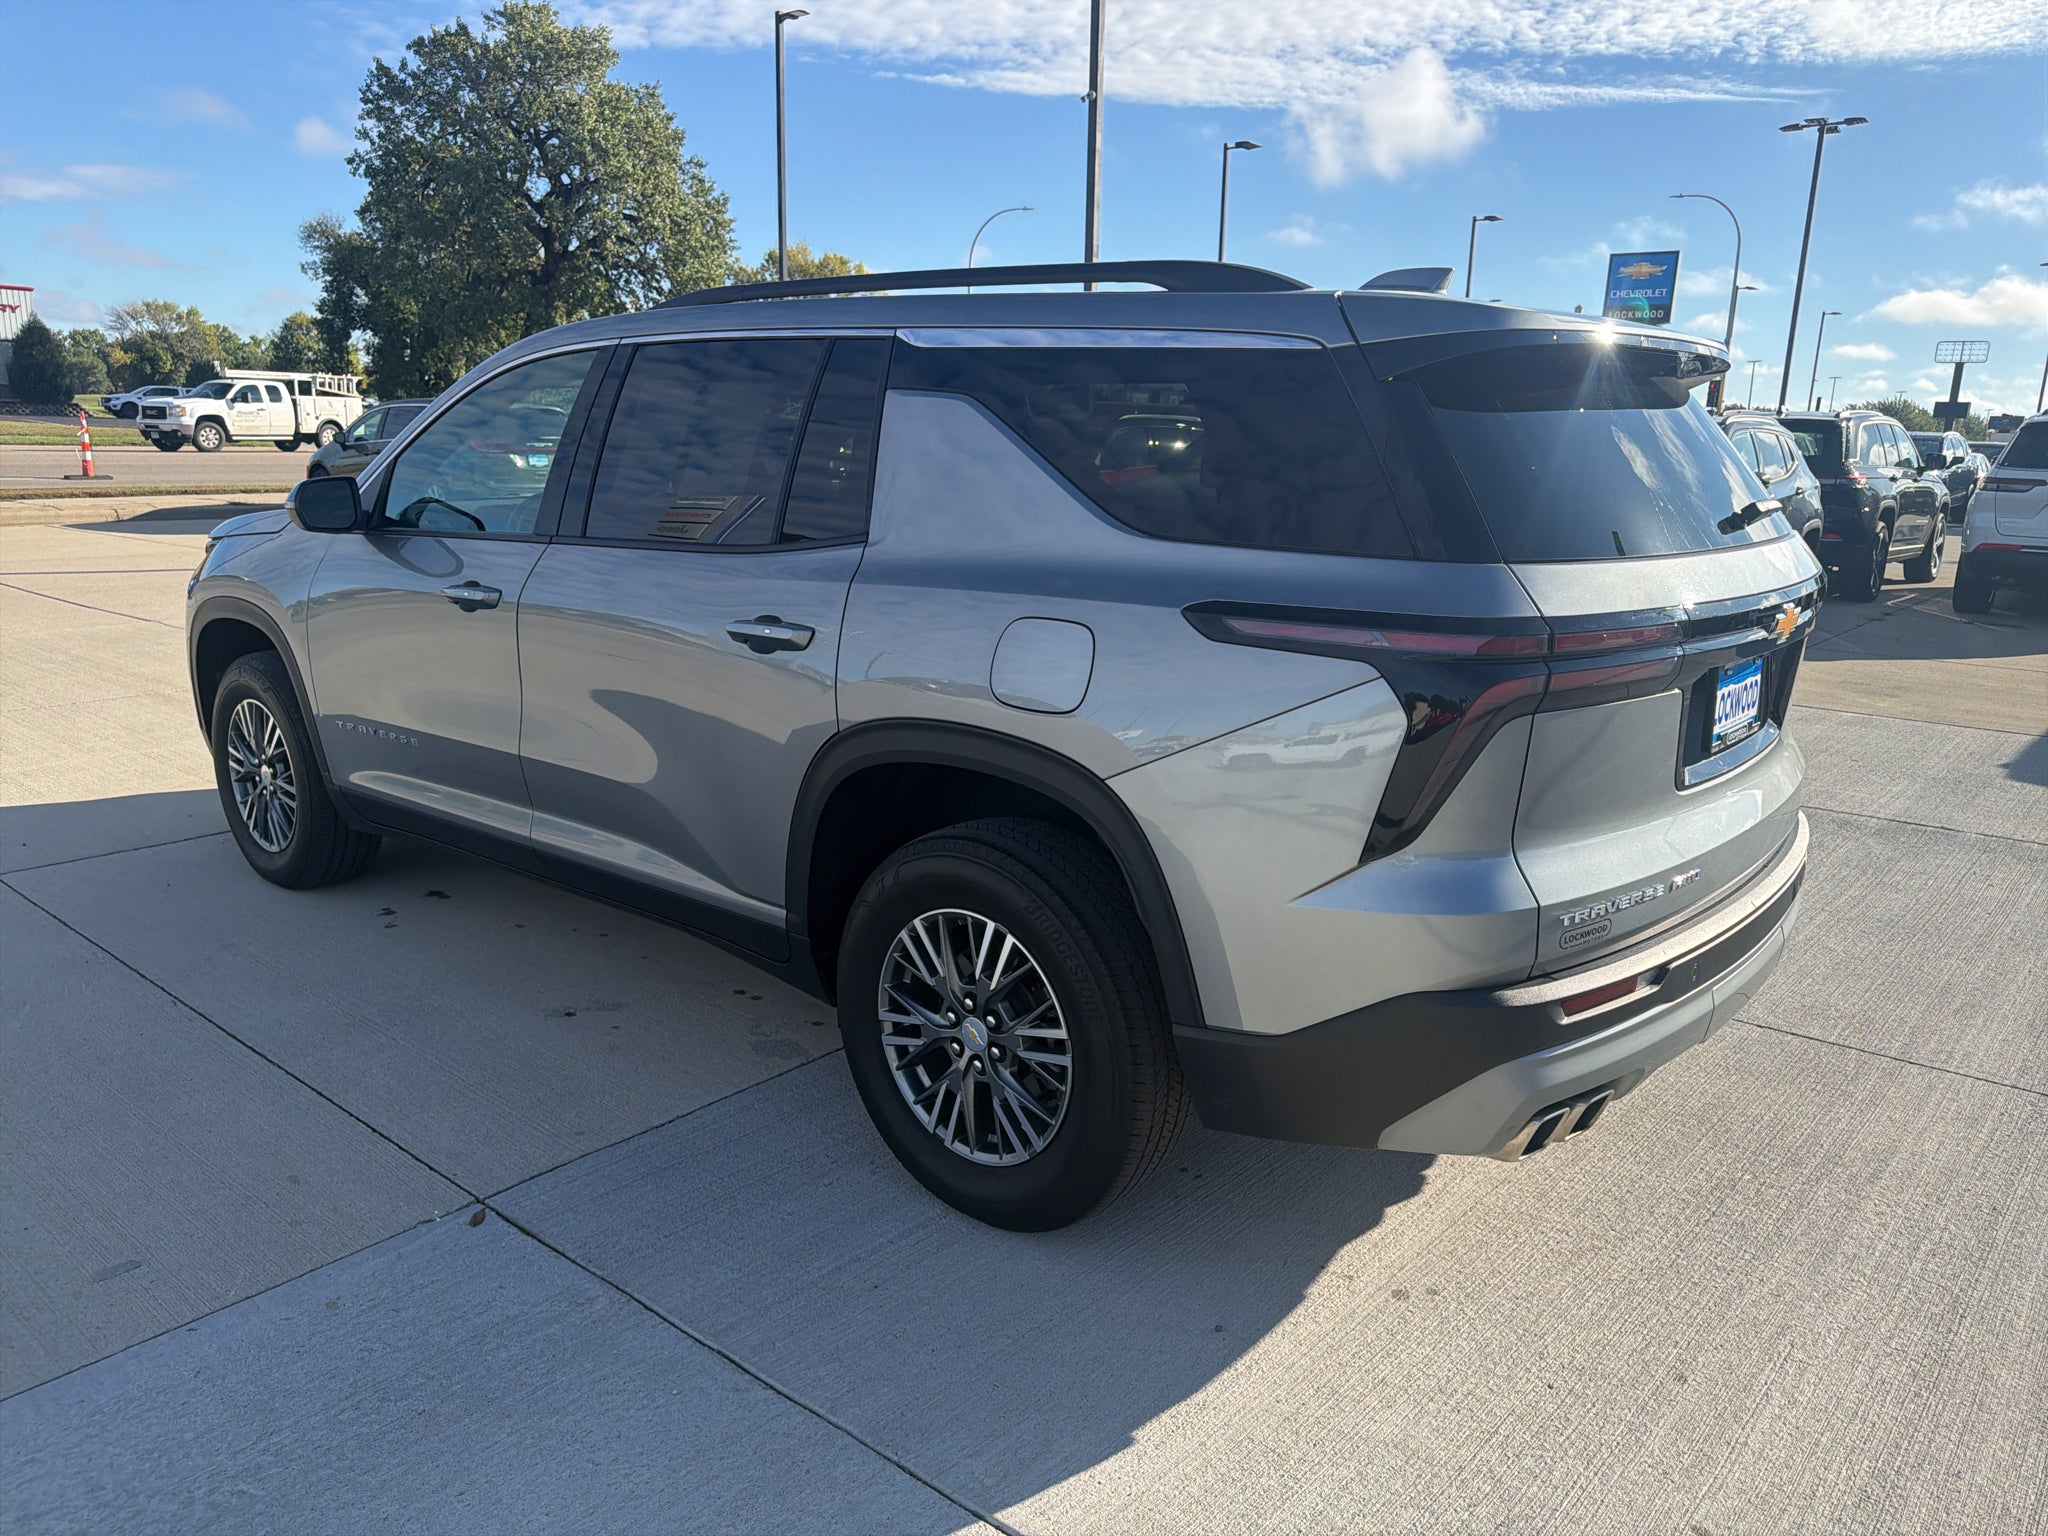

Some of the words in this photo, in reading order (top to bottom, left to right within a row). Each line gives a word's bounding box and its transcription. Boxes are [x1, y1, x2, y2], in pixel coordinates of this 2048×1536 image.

[1610, 288, 1668, 298] CHEVROLET
[1713, 679, 1759, 725] OCKWOOD
[335, 720, 419, 747] TRAVERSE
[1560, 883, 1665, 927] TRAVERSE
[1563, 923, 1609, 945] LOCKWOOD
